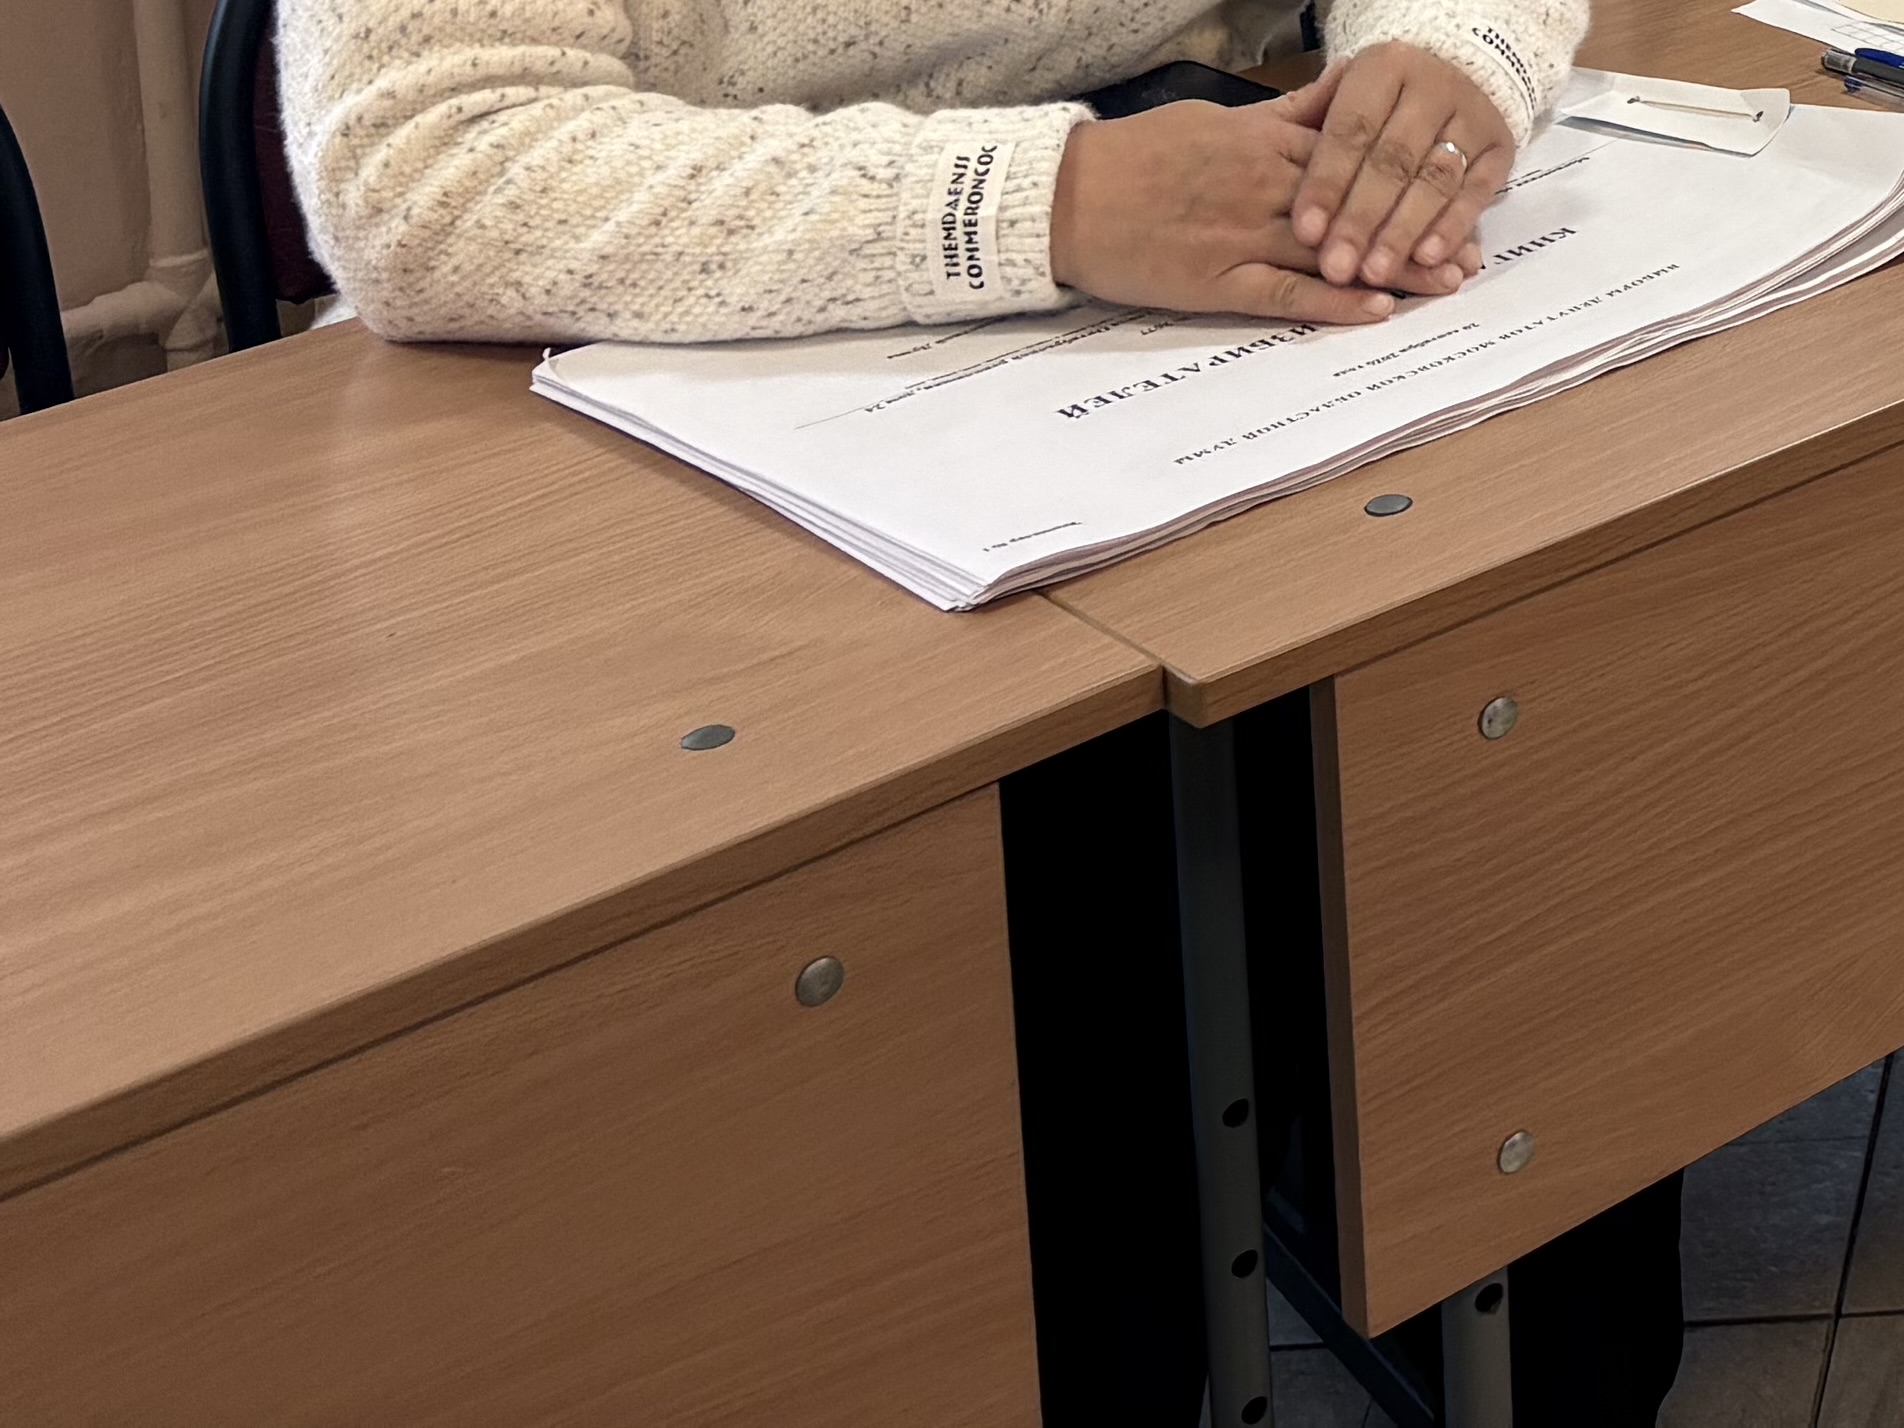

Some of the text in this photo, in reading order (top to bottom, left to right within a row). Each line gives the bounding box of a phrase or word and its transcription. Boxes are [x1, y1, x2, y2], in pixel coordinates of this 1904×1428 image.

[1056, 322, 1317, 420] ИЗБИРАТЕЛЕЙ
[1173, 263, 1680, 466] ВЫБОРЫ ДЕПУТАТОВ МОСКОВСКОЙ ОБЛАСТНОЙ ДУМЫ
